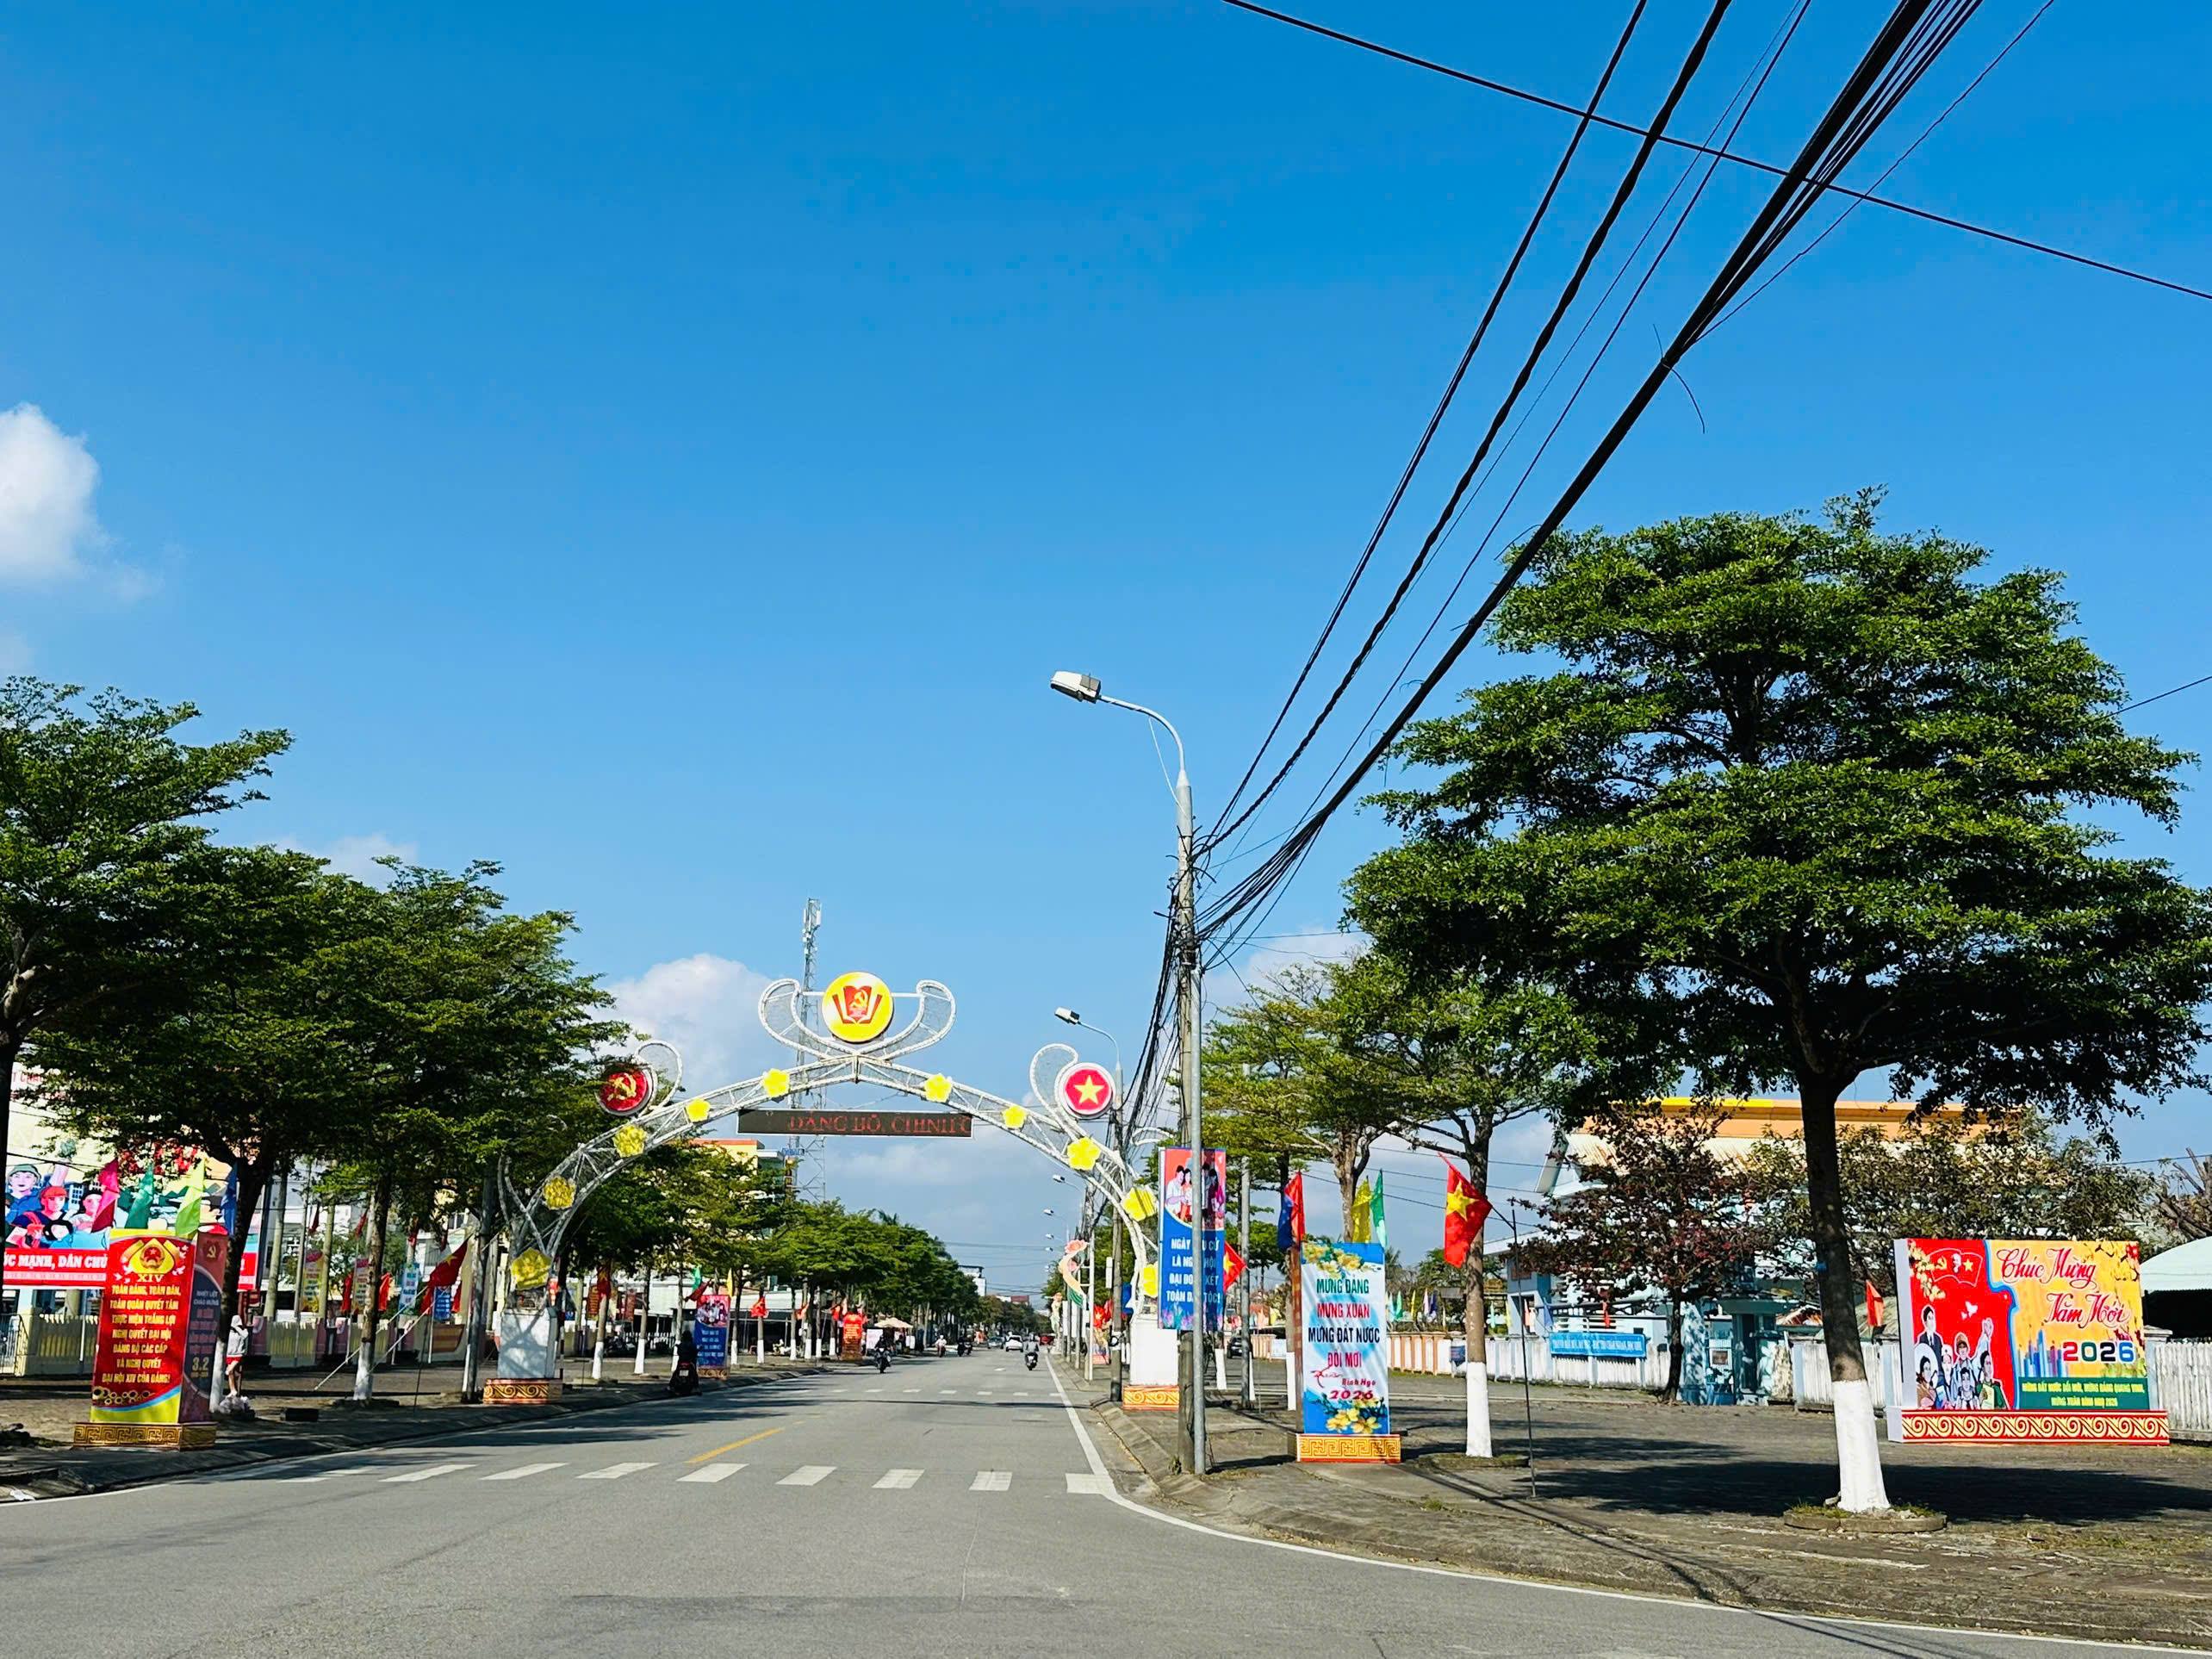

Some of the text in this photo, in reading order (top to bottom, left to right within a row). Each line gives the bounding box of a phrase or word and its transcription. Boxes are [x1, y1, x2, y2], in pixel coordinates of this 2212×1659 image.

[1171, 1237, 1190, 1250] NGÀY
[18, 1254, 55, 1270] MẠNH,
[58, 1253, 83, 1268] DÂN
[84, 1253, 109, 1268] CHỦ
[1172, 1254, 1182, 1267] LÀ
[1997, 1247, 2097, 1289] Chúc Mừng
[137, 1274, 165, 1283] XIV
[1166, 1289, 1186, 1302] TOÀN
[2044, 1293, 2129, 1328] Năm Mới
[1356, 1325, 1380, 1343] NƯỚC
[2063, 1341, 2134, 1362] 2026
[1329, 1390, 1374, 1400] 2026
